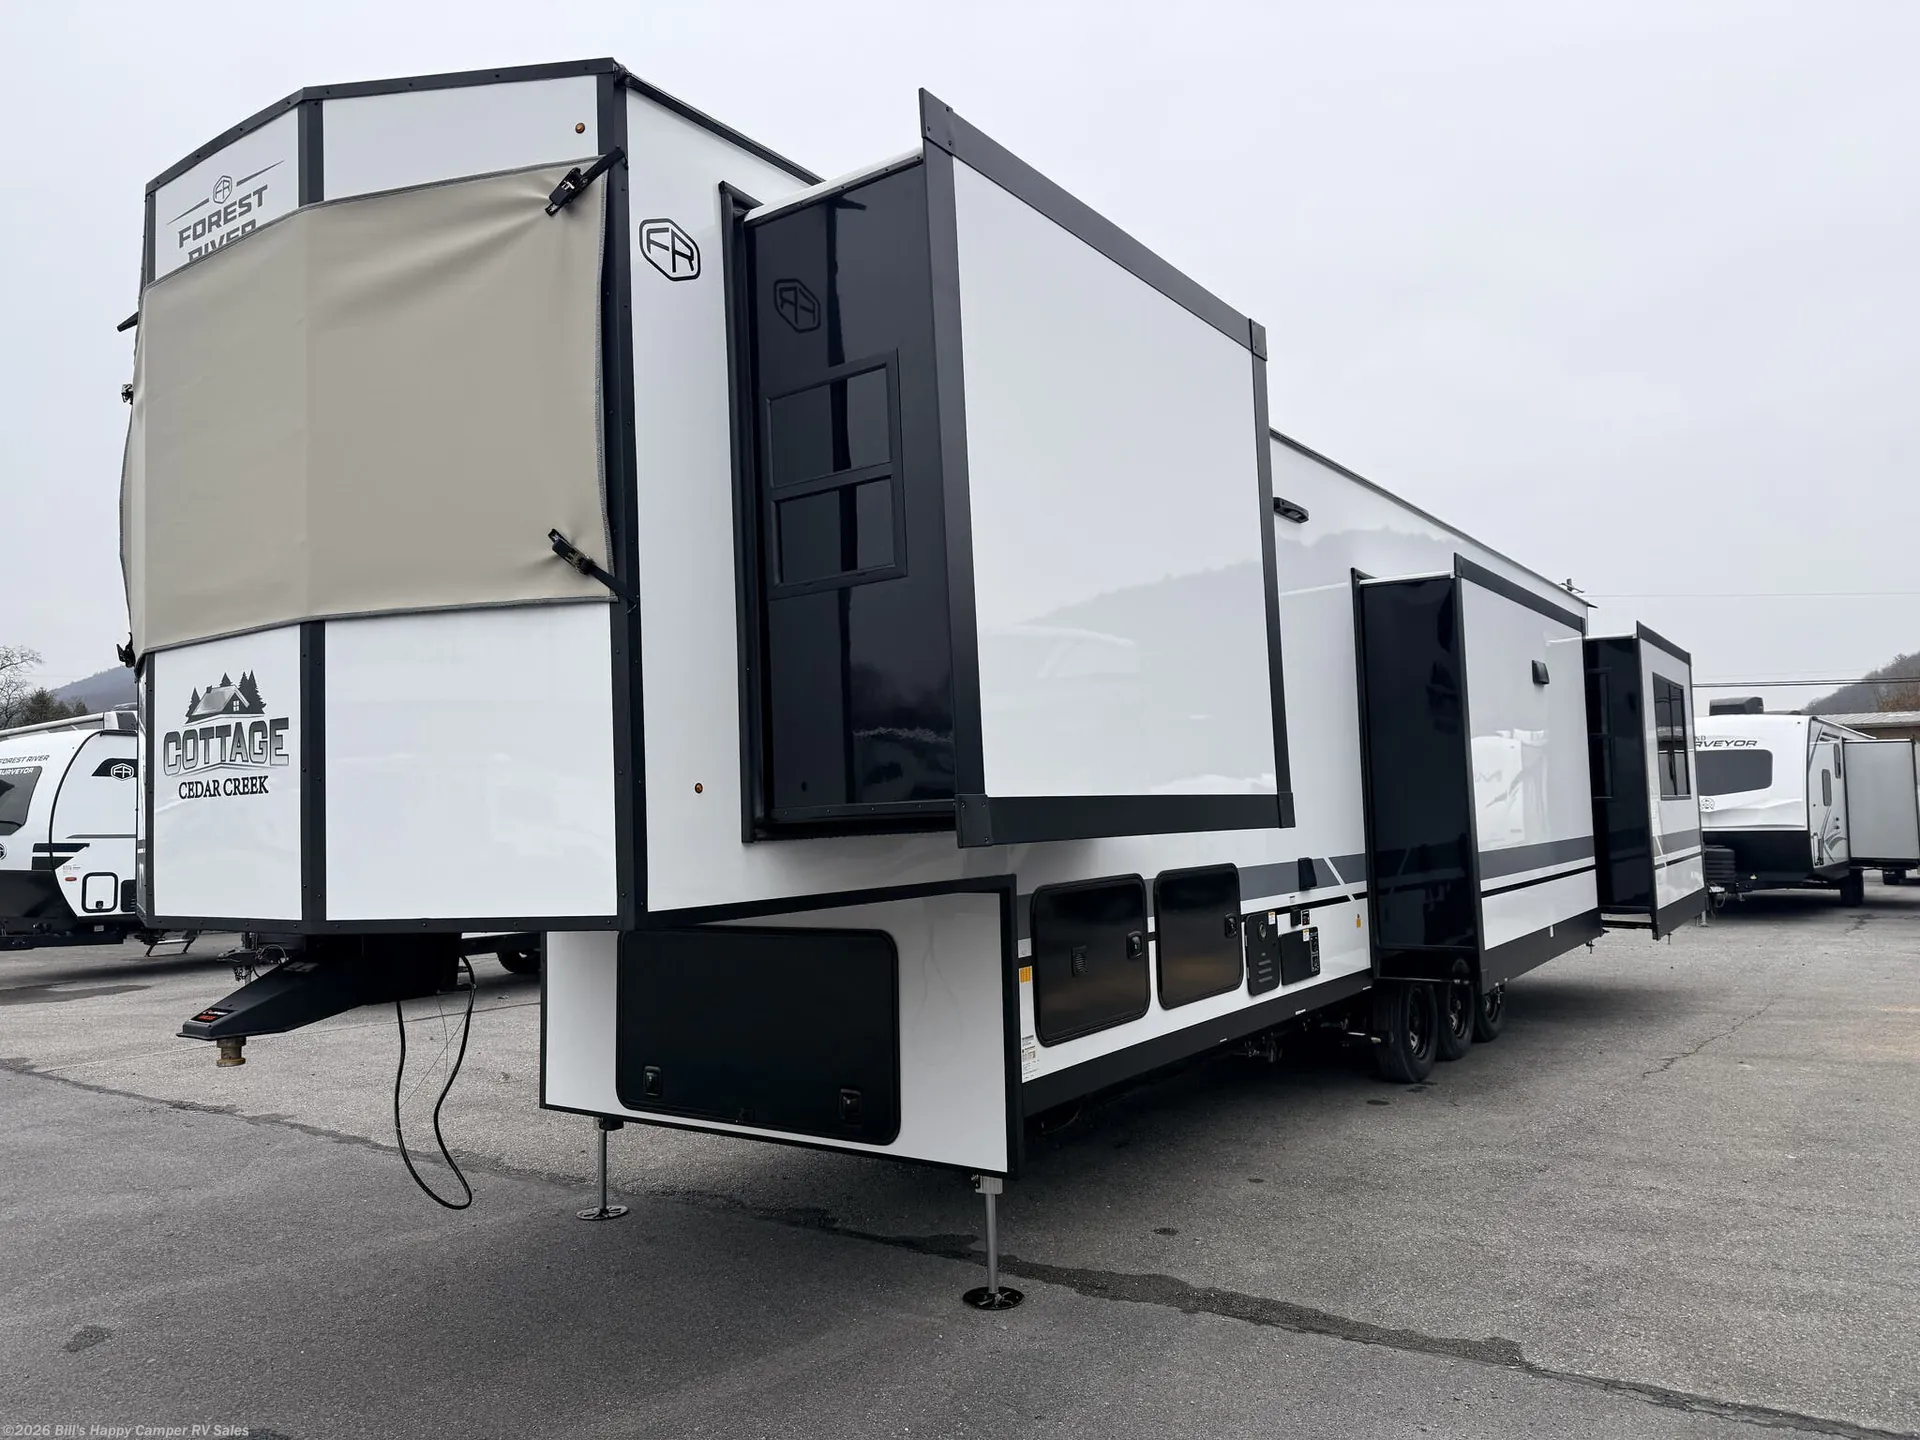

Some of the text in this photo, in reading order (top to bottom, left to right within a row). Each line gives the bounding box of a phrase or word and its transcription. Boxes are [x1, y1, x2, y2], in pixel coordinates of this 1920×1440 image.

[178, 184, 268, 249] FOREST
[163, 717, 290, 776] COTTAGE
[179, 775, 269, 799] CEDAR CREEK
